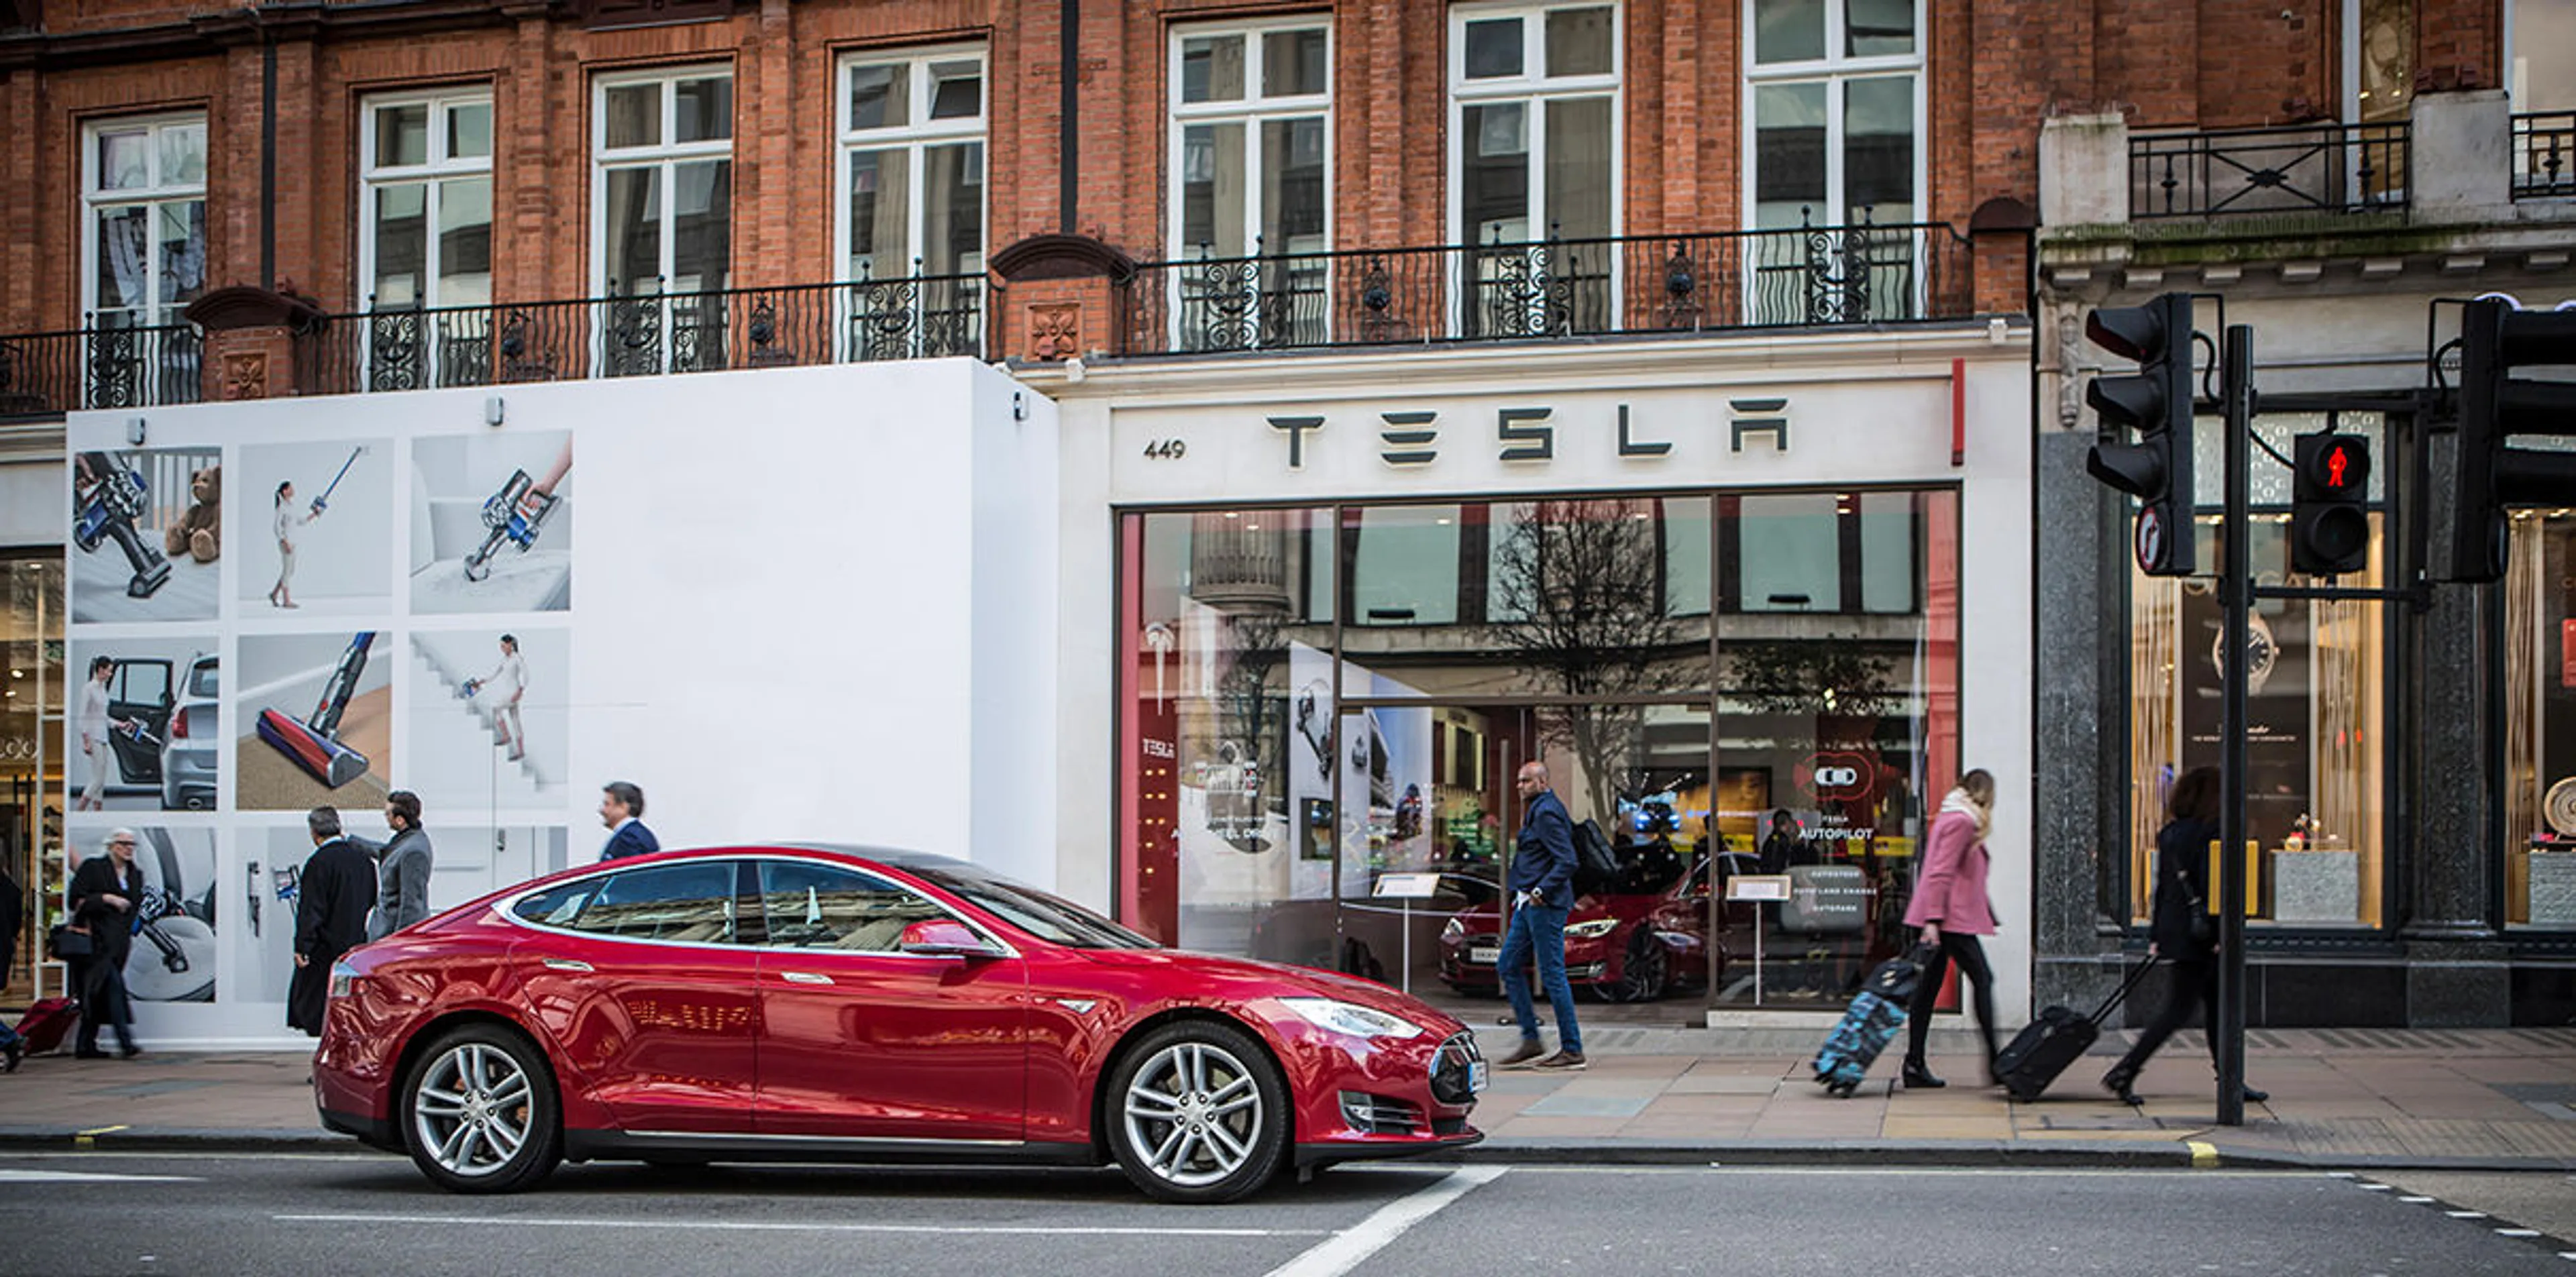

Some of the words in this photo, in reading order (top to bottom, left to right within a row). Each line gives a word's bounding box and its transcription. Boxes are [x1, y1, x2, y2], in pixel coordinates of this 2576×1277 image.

[1266, 398, 1788, 467] TESLA
[1143, 439, 1186, 459] 449
[1798, 827, 1874, 840] AUTOPILOT
